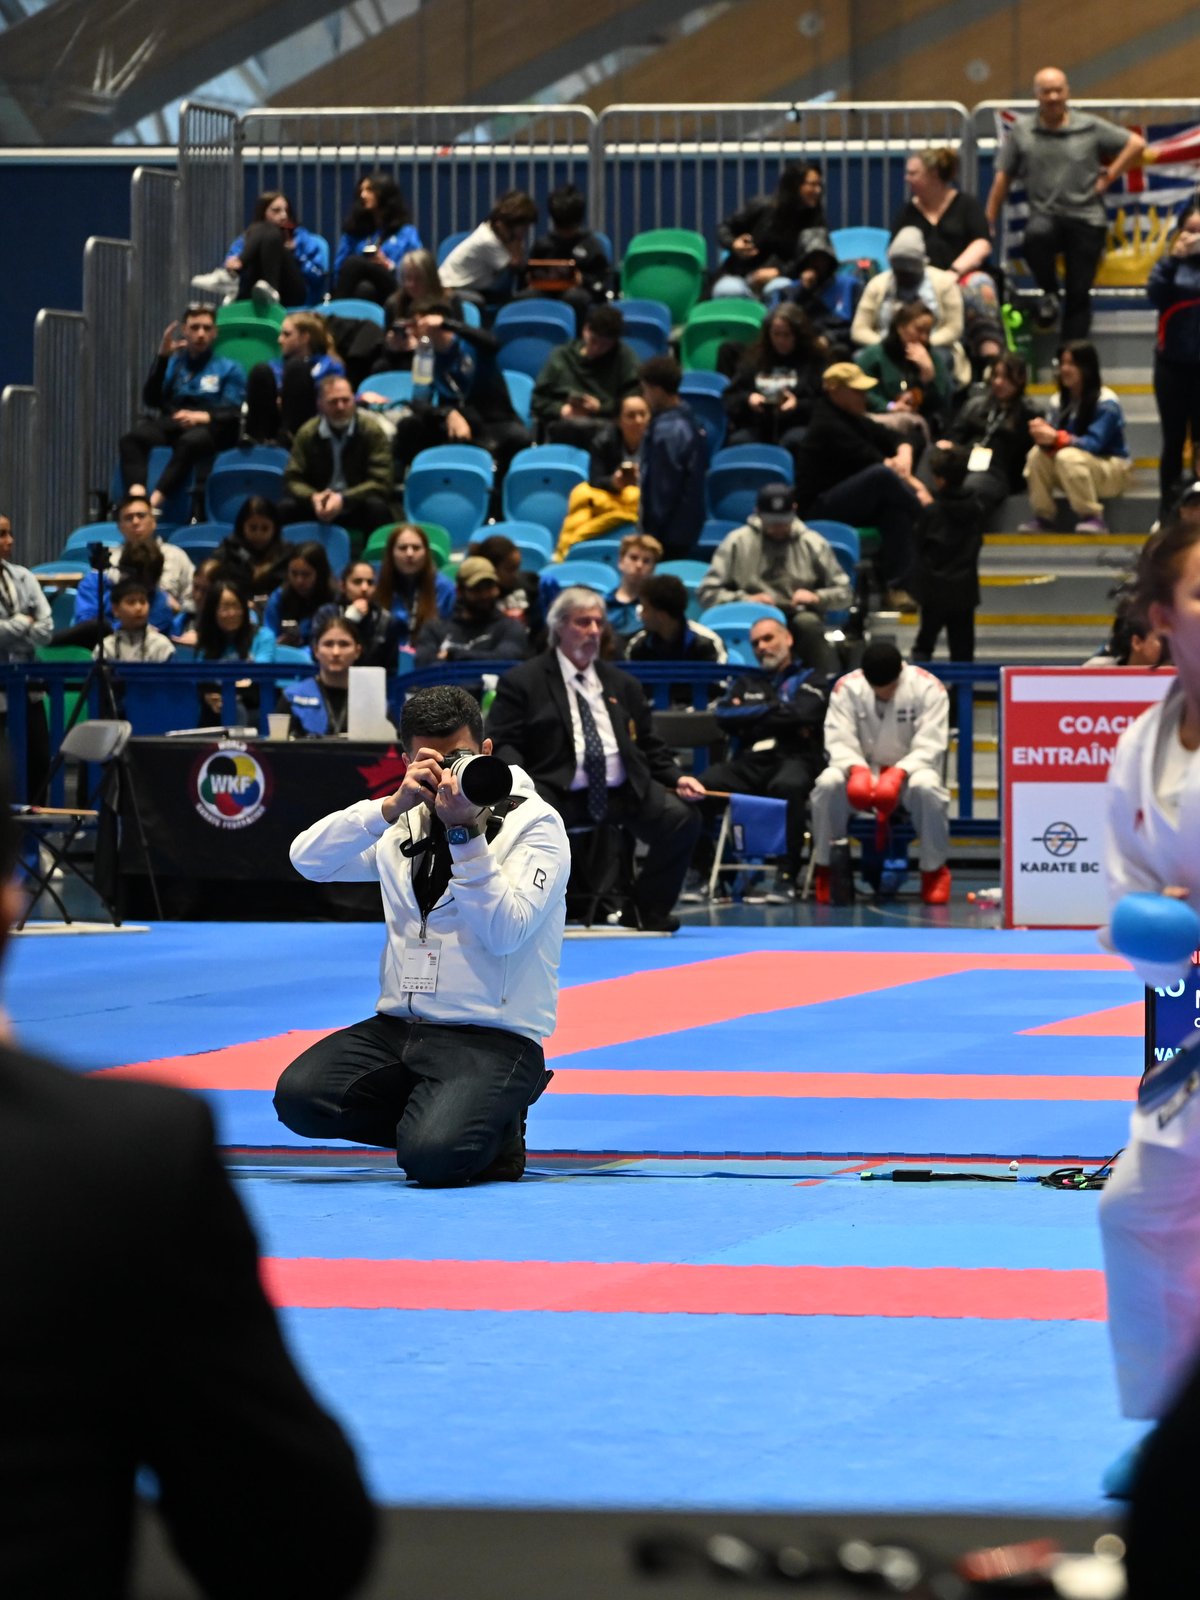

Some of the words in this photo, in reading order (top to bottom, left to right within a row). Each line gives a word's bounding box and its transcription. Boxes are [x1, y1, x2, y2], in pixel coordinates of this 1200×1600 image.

[210, 775, 251, 795] WKF
[1020, 862, 1078, 873] KARATE
[1081, 862, 1099, 873] BC
